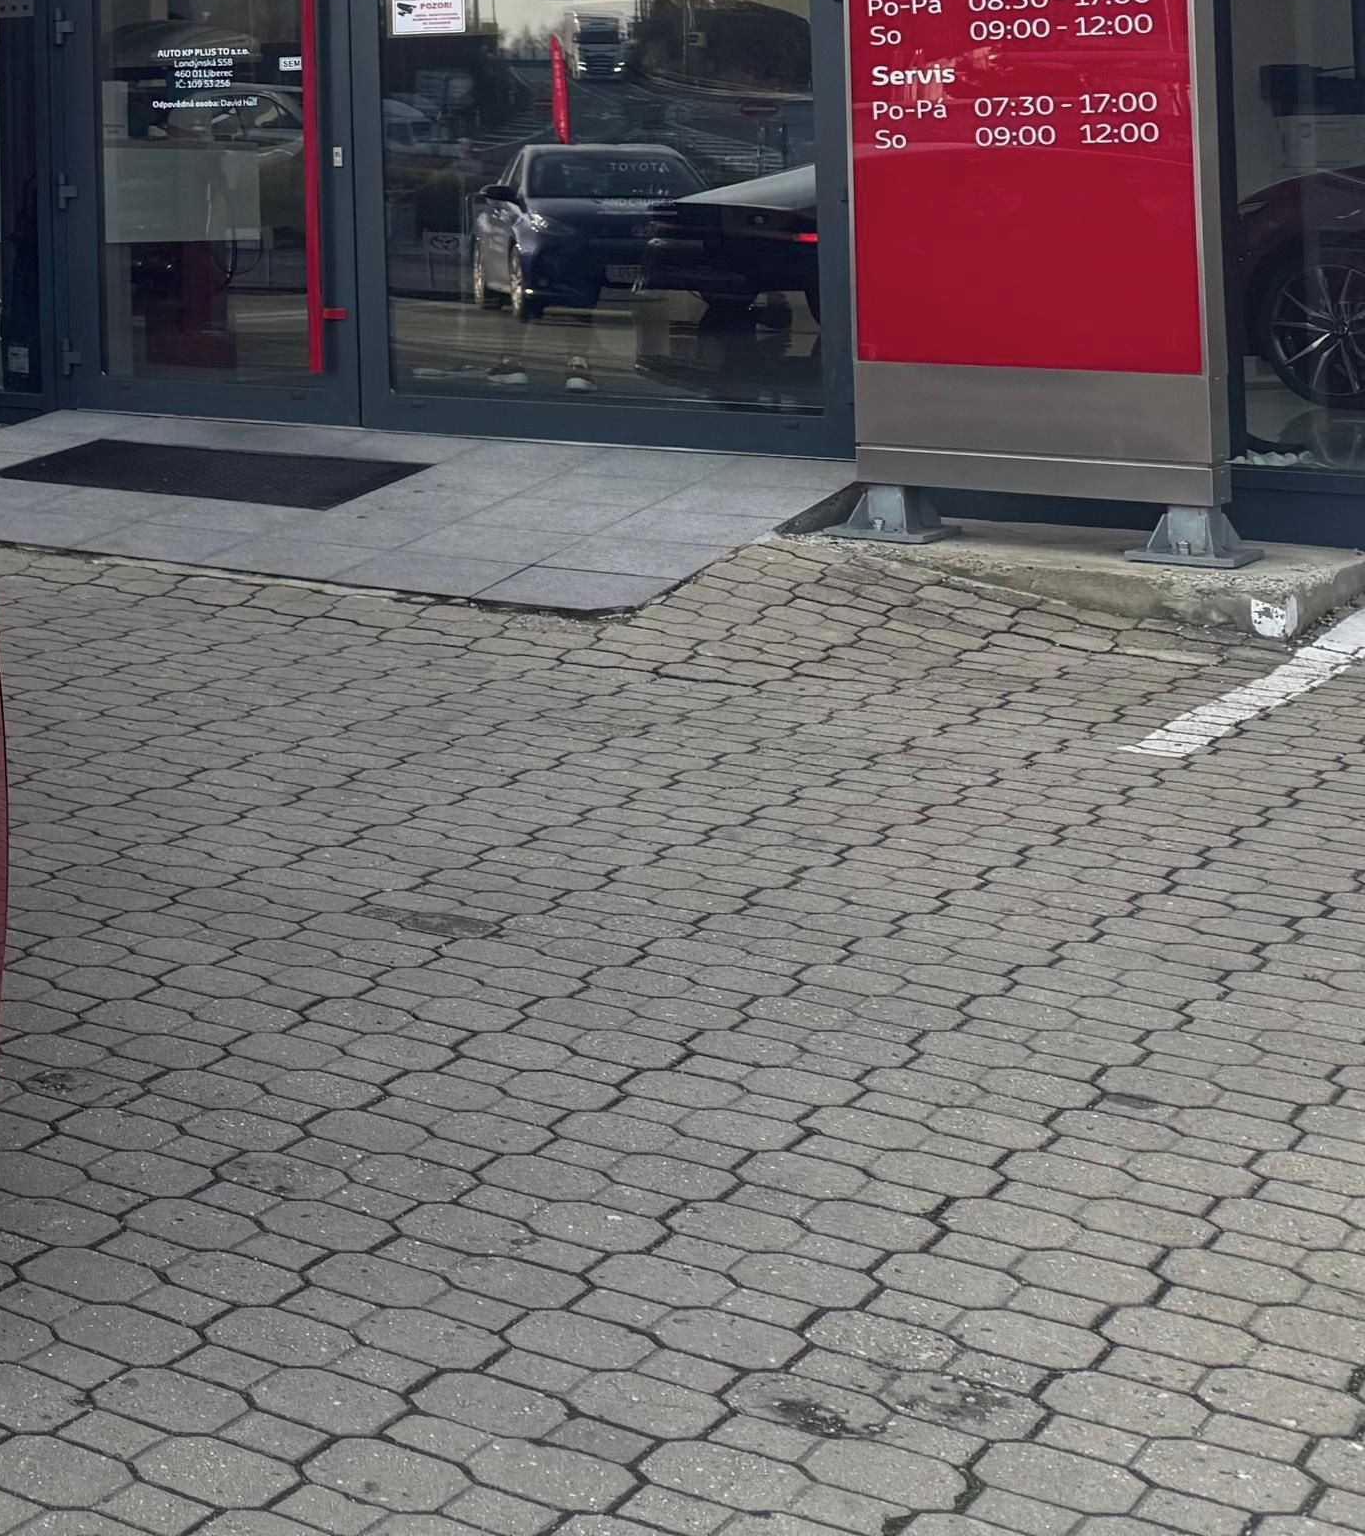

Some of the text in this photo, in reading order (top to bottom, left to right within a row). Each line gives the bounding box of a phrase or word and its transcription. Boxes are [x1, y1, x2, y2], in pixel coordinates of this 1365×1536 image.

[870, 26, 902, 47] So
[969, 18, 1051, 42] 09:00
[1074, 13, 1153, 37] 12:00
[157, 49, 181, 58] AUTO
[182, 48, 194, 57] KP
[195, 48, 217, 57] PLUS
[219, 47, 229, 56] TO
[218, 58, 233, 66] 558
[174, 69, 233, 78] 460 01 Liberec
[871, 64, 955, 87] Servis
[187, 80, 202, 88] 109
[204, 80, 215, 88] 53
[216, 79, 231, 88] 256
[220, 99, 241, 107] David
[872, 98, 948, 121] Po-Pá
[974, 94, 1054, 118] 07:30
[1079, 91, 1158, 114] 17:00
[874, 129, 908, 150] So
[974, 124, 1056, 147] 09:00
[1079, 121, 1159, 144] 12:00
